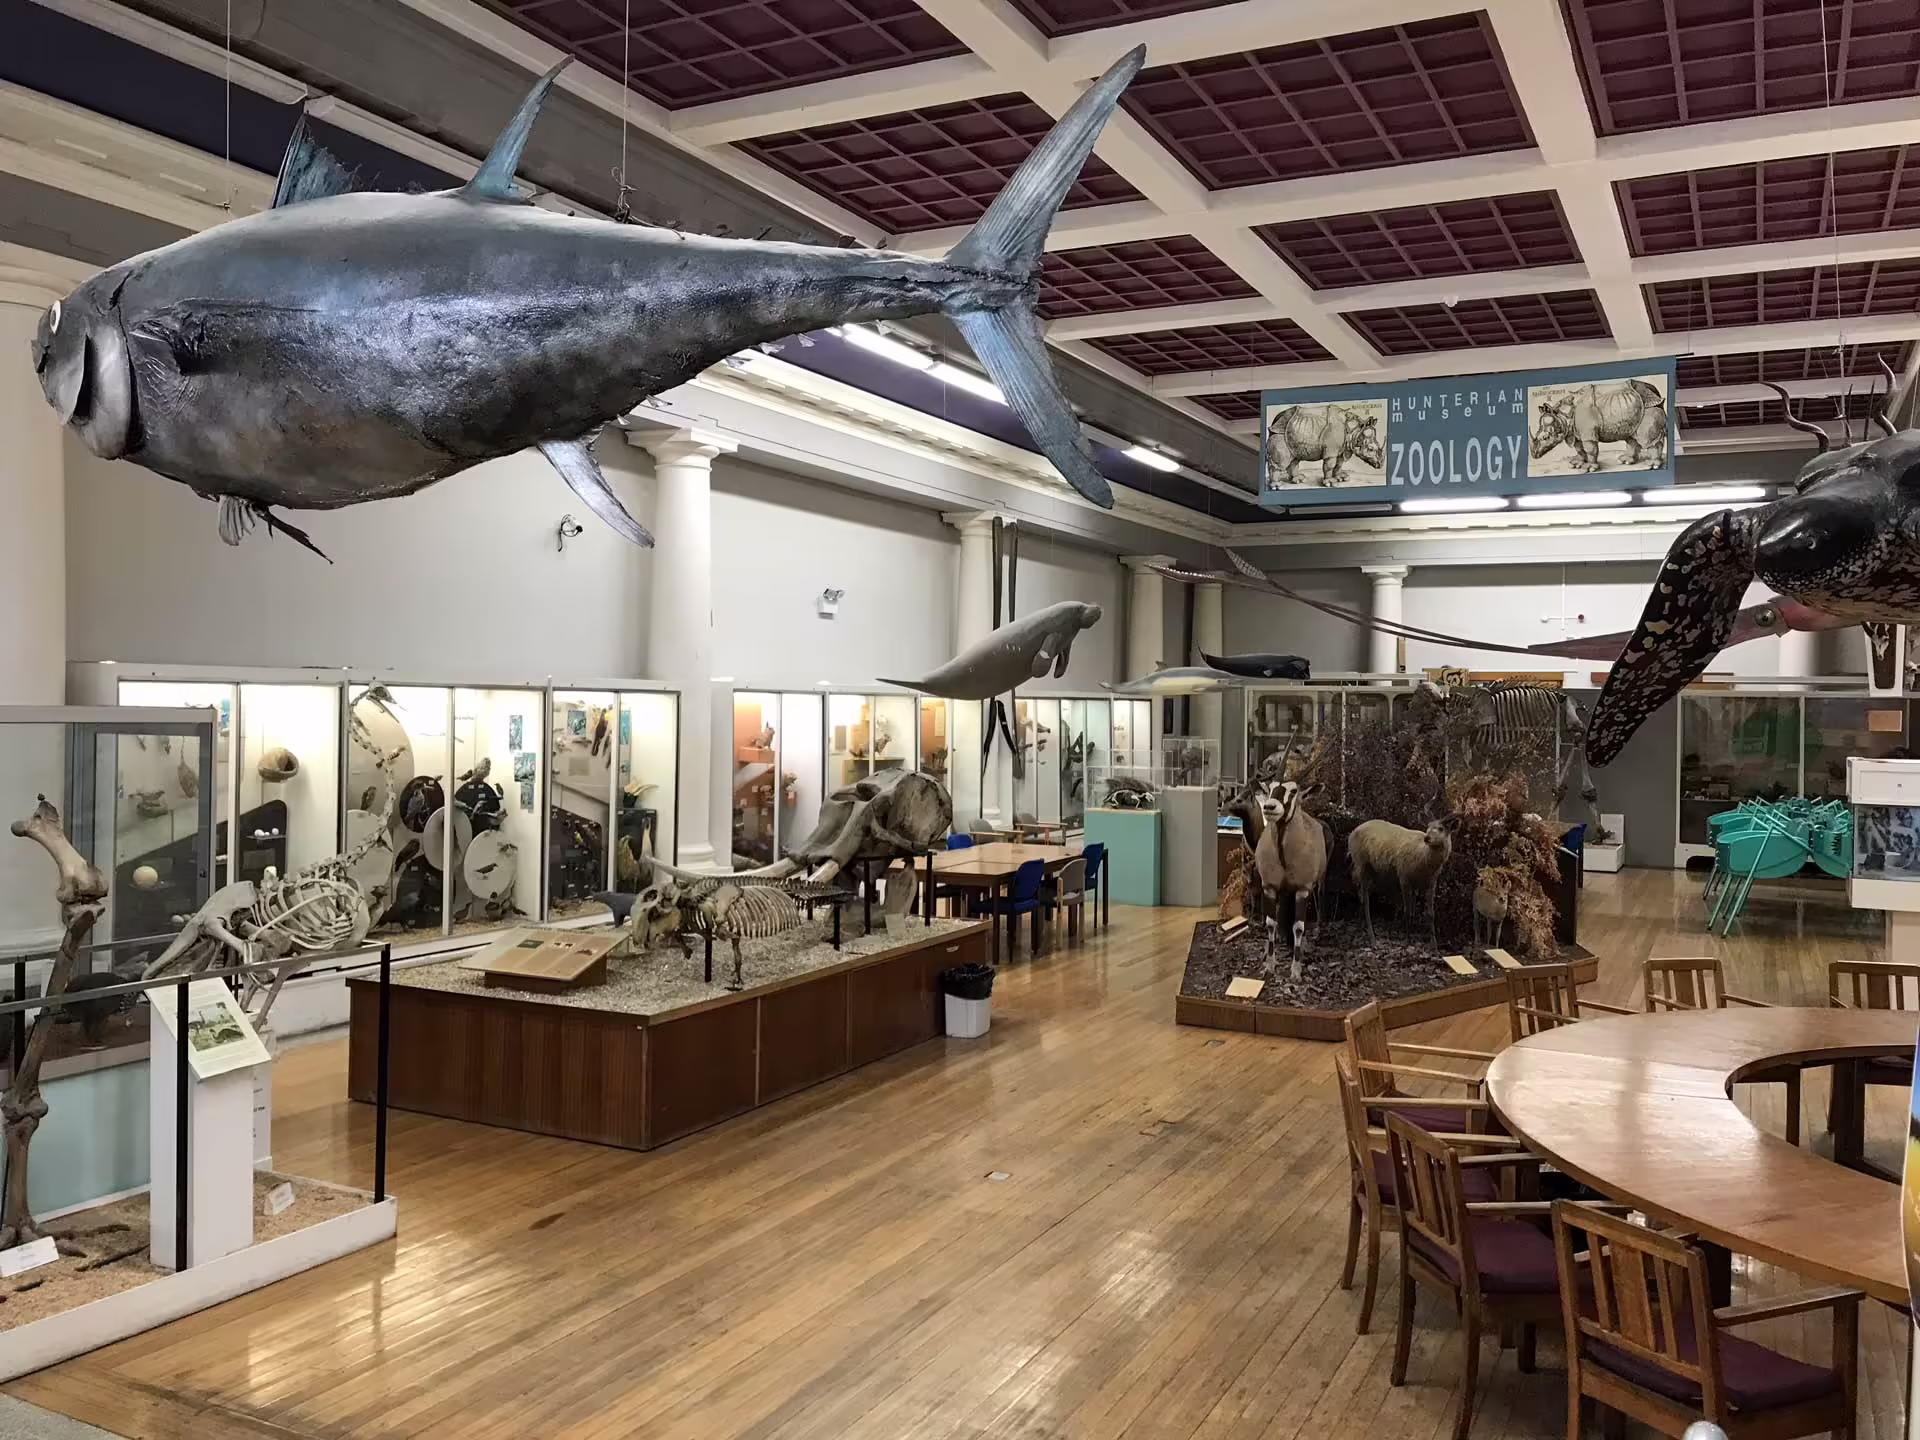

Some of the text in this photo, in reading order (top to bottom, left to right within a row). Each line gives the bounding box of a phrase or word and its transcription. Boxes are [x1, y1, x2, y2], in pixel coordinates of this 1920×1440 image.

[1392, 388, 1523, 411] HUNTERIAN
[1392, 402, 1524, 423] museum
[1391, 434, 1522, 486] ZOOLOGY
